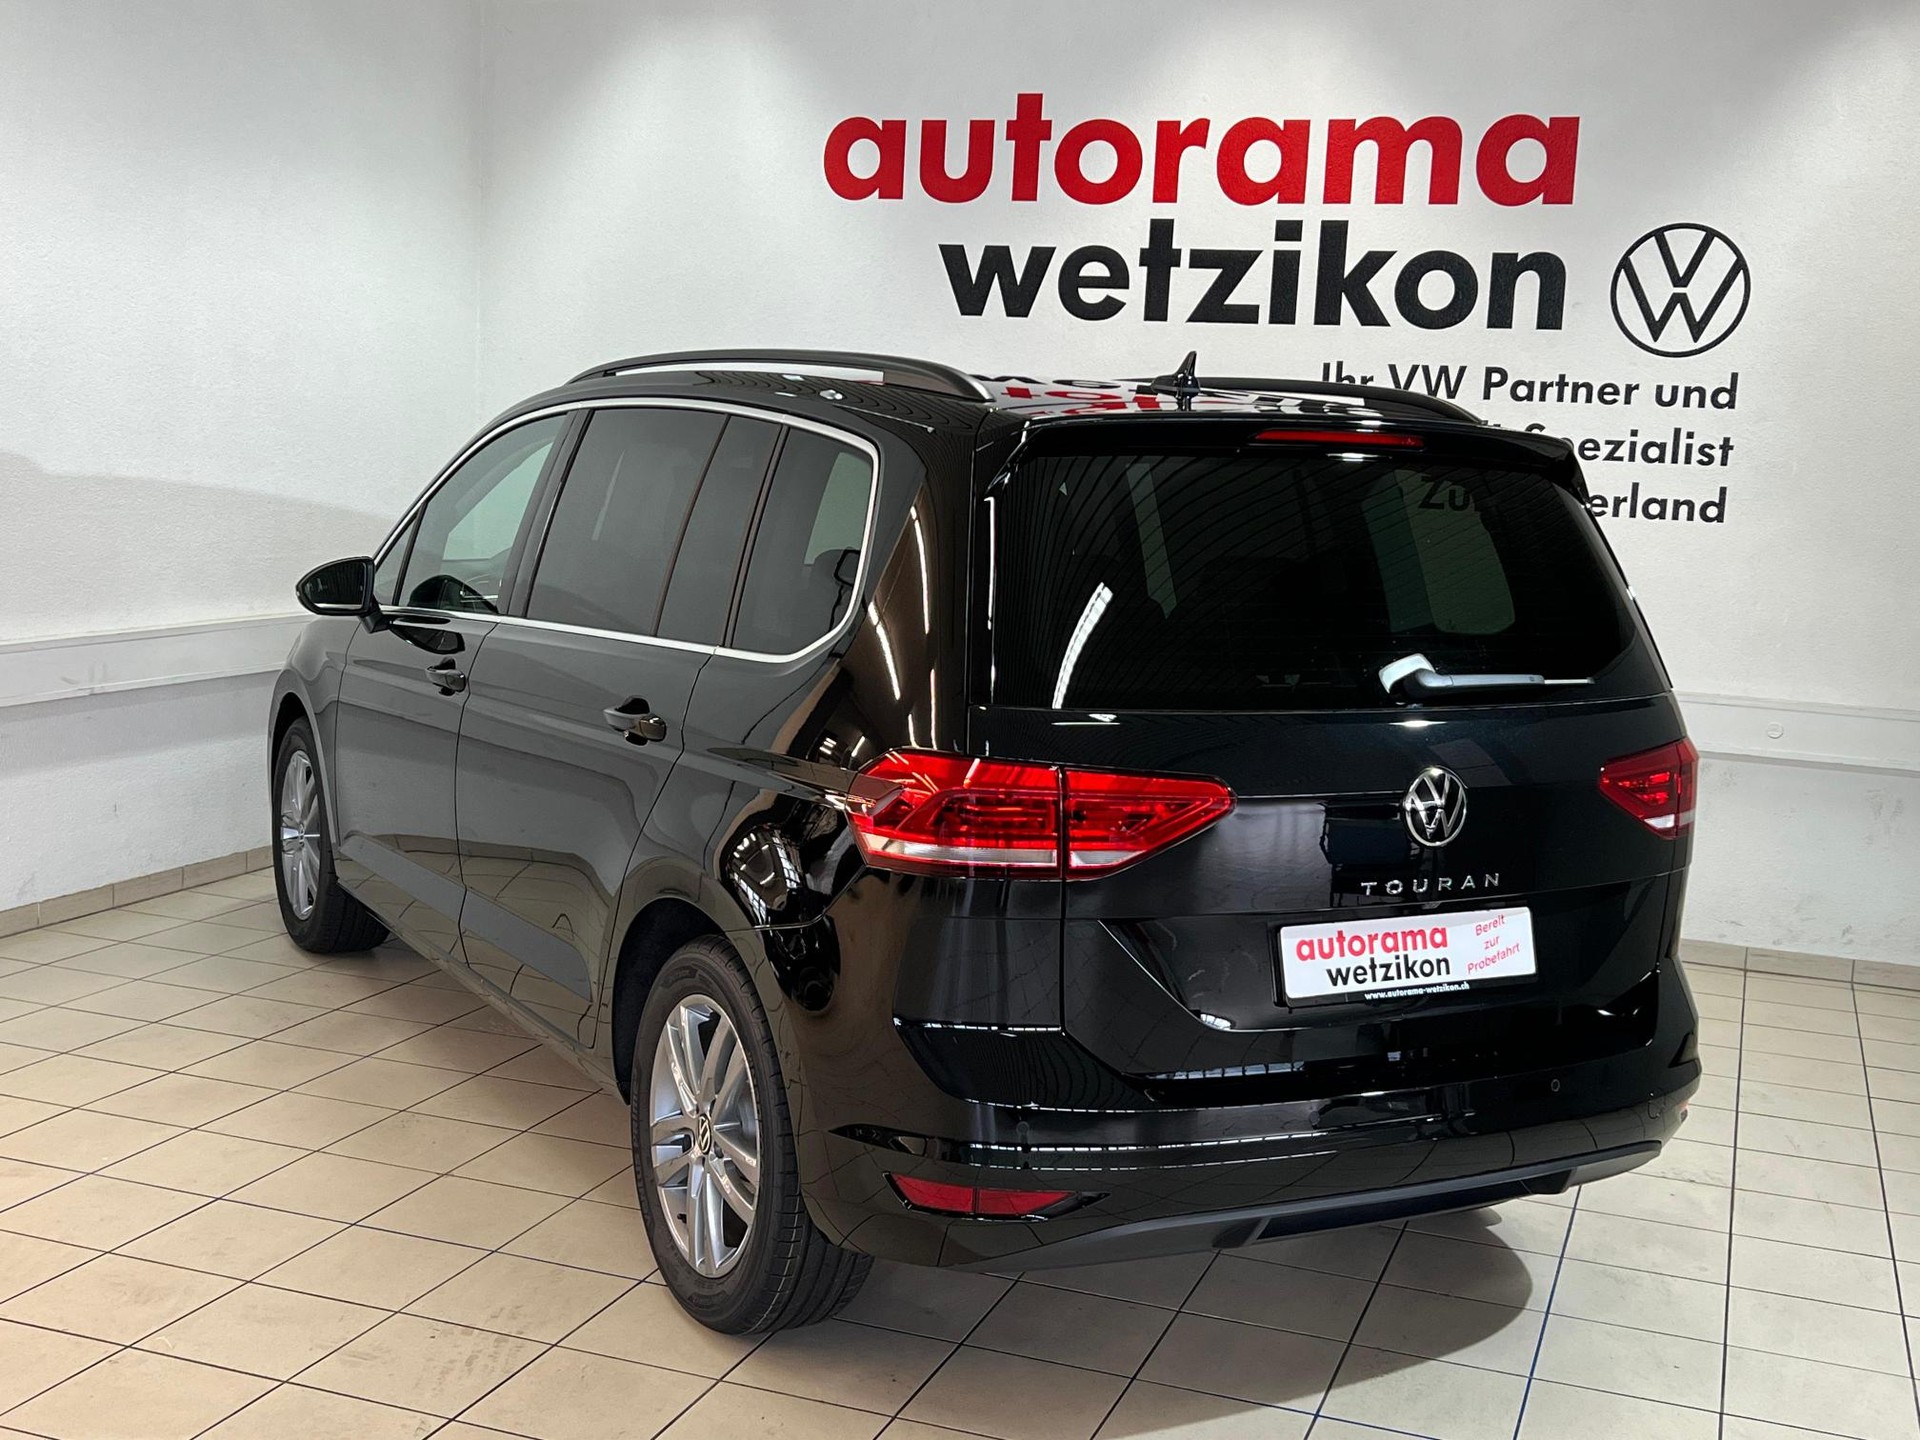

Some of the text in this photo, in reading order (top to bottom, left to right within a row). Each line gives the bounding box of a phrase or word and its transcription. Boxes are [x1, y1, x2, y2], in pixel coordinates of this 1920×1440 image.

[824, 93, 1580, 206] autorama
[939, 218, 1567, 330] wetzikon
[1388, 364, 1468, 400] VW
[1483, 366, 1640, 407] Partner
[1654, 372, 1740, 410] und
[1525, 423, 1735, 467] ezialist
[1590, 482, 1729, 524] erland
[1361, 872, 1500, 896] TOURAN
[1475, 914, 1505, 936] Bereit
[1296, 927, 1448, 962] autorama
[1467, 943, 1521, 974] Probefahrt
[1484, 935, 1500, 950] zur
[1326, 954, 1451, 987] wetzikon
[1364, 981, 1470, 1000] www.autorama-wetzikon.ch
